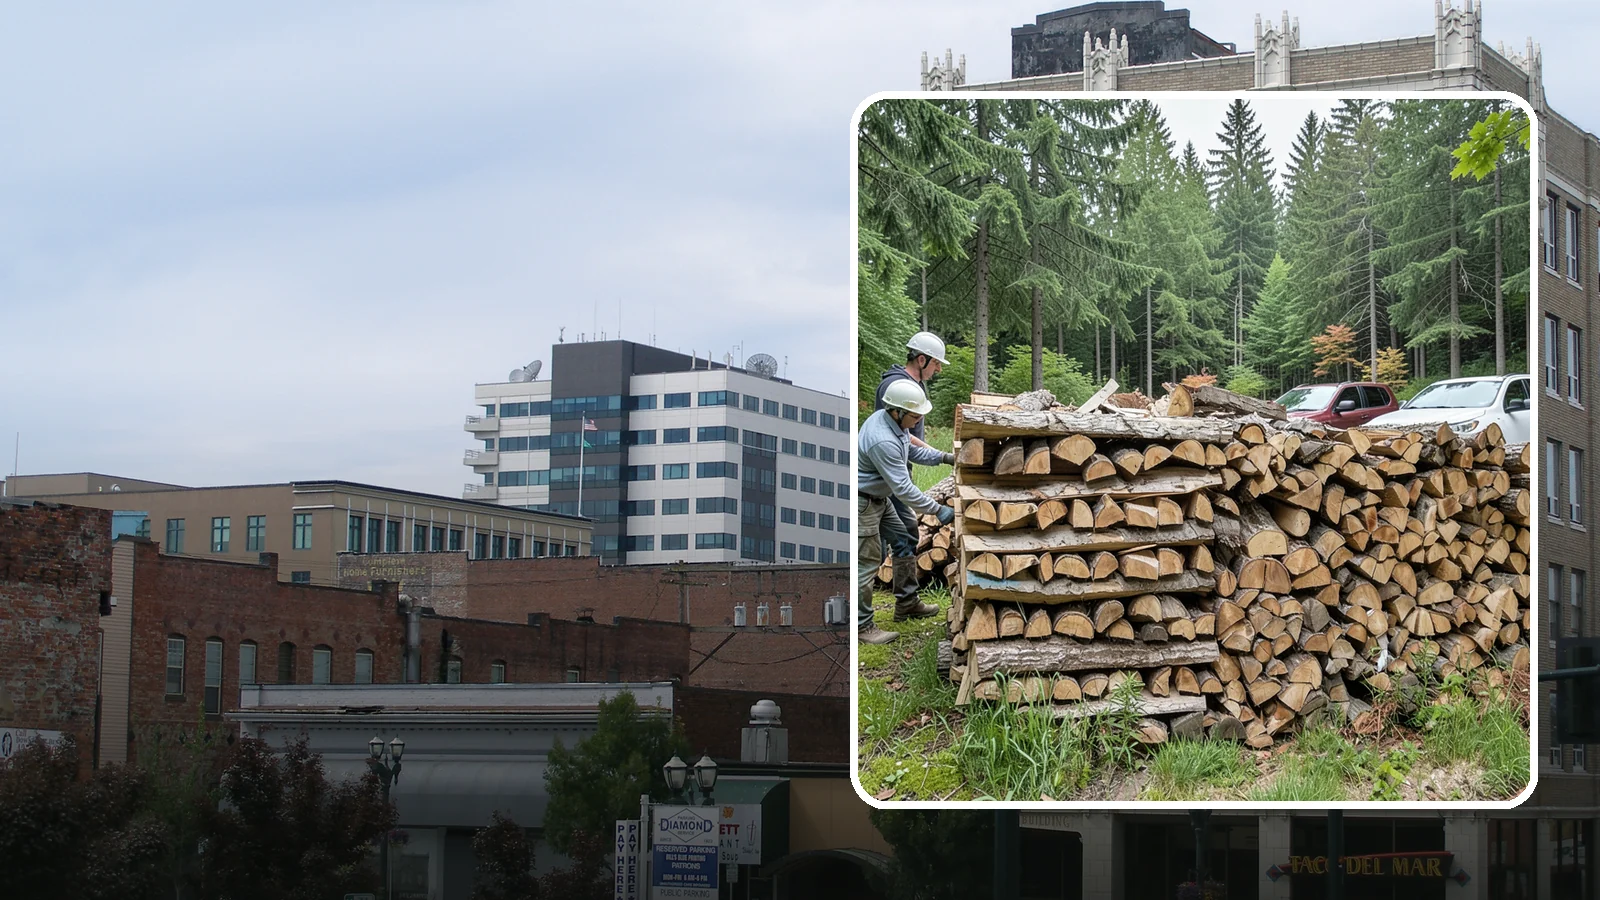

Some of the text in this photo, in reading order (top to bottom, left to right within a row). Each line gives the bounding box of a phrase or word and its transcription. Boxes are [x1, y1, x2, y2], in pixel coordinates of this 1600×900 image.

[370, 565, 427, 577] Furnishers
[660, 818, 713, 833] DIAMOND
[1022, 815, 1070, 828] BUILDING
[719, 824, 740, 835] ETT
[655, 845, 716, 854] RESERVED PARKING
[616, 825, 625, 894] PAY HERE
[627, 825, 637, 894] PAY HERE
[721, 851, 739, 863] Soup
[671, 862, 701, 870] PATRONS
[1345, 856, 1386, 877] DEL
[1392, 857, 1444, 878] MAR
[660, 888, 710, 899] PUBLIC PARKING
